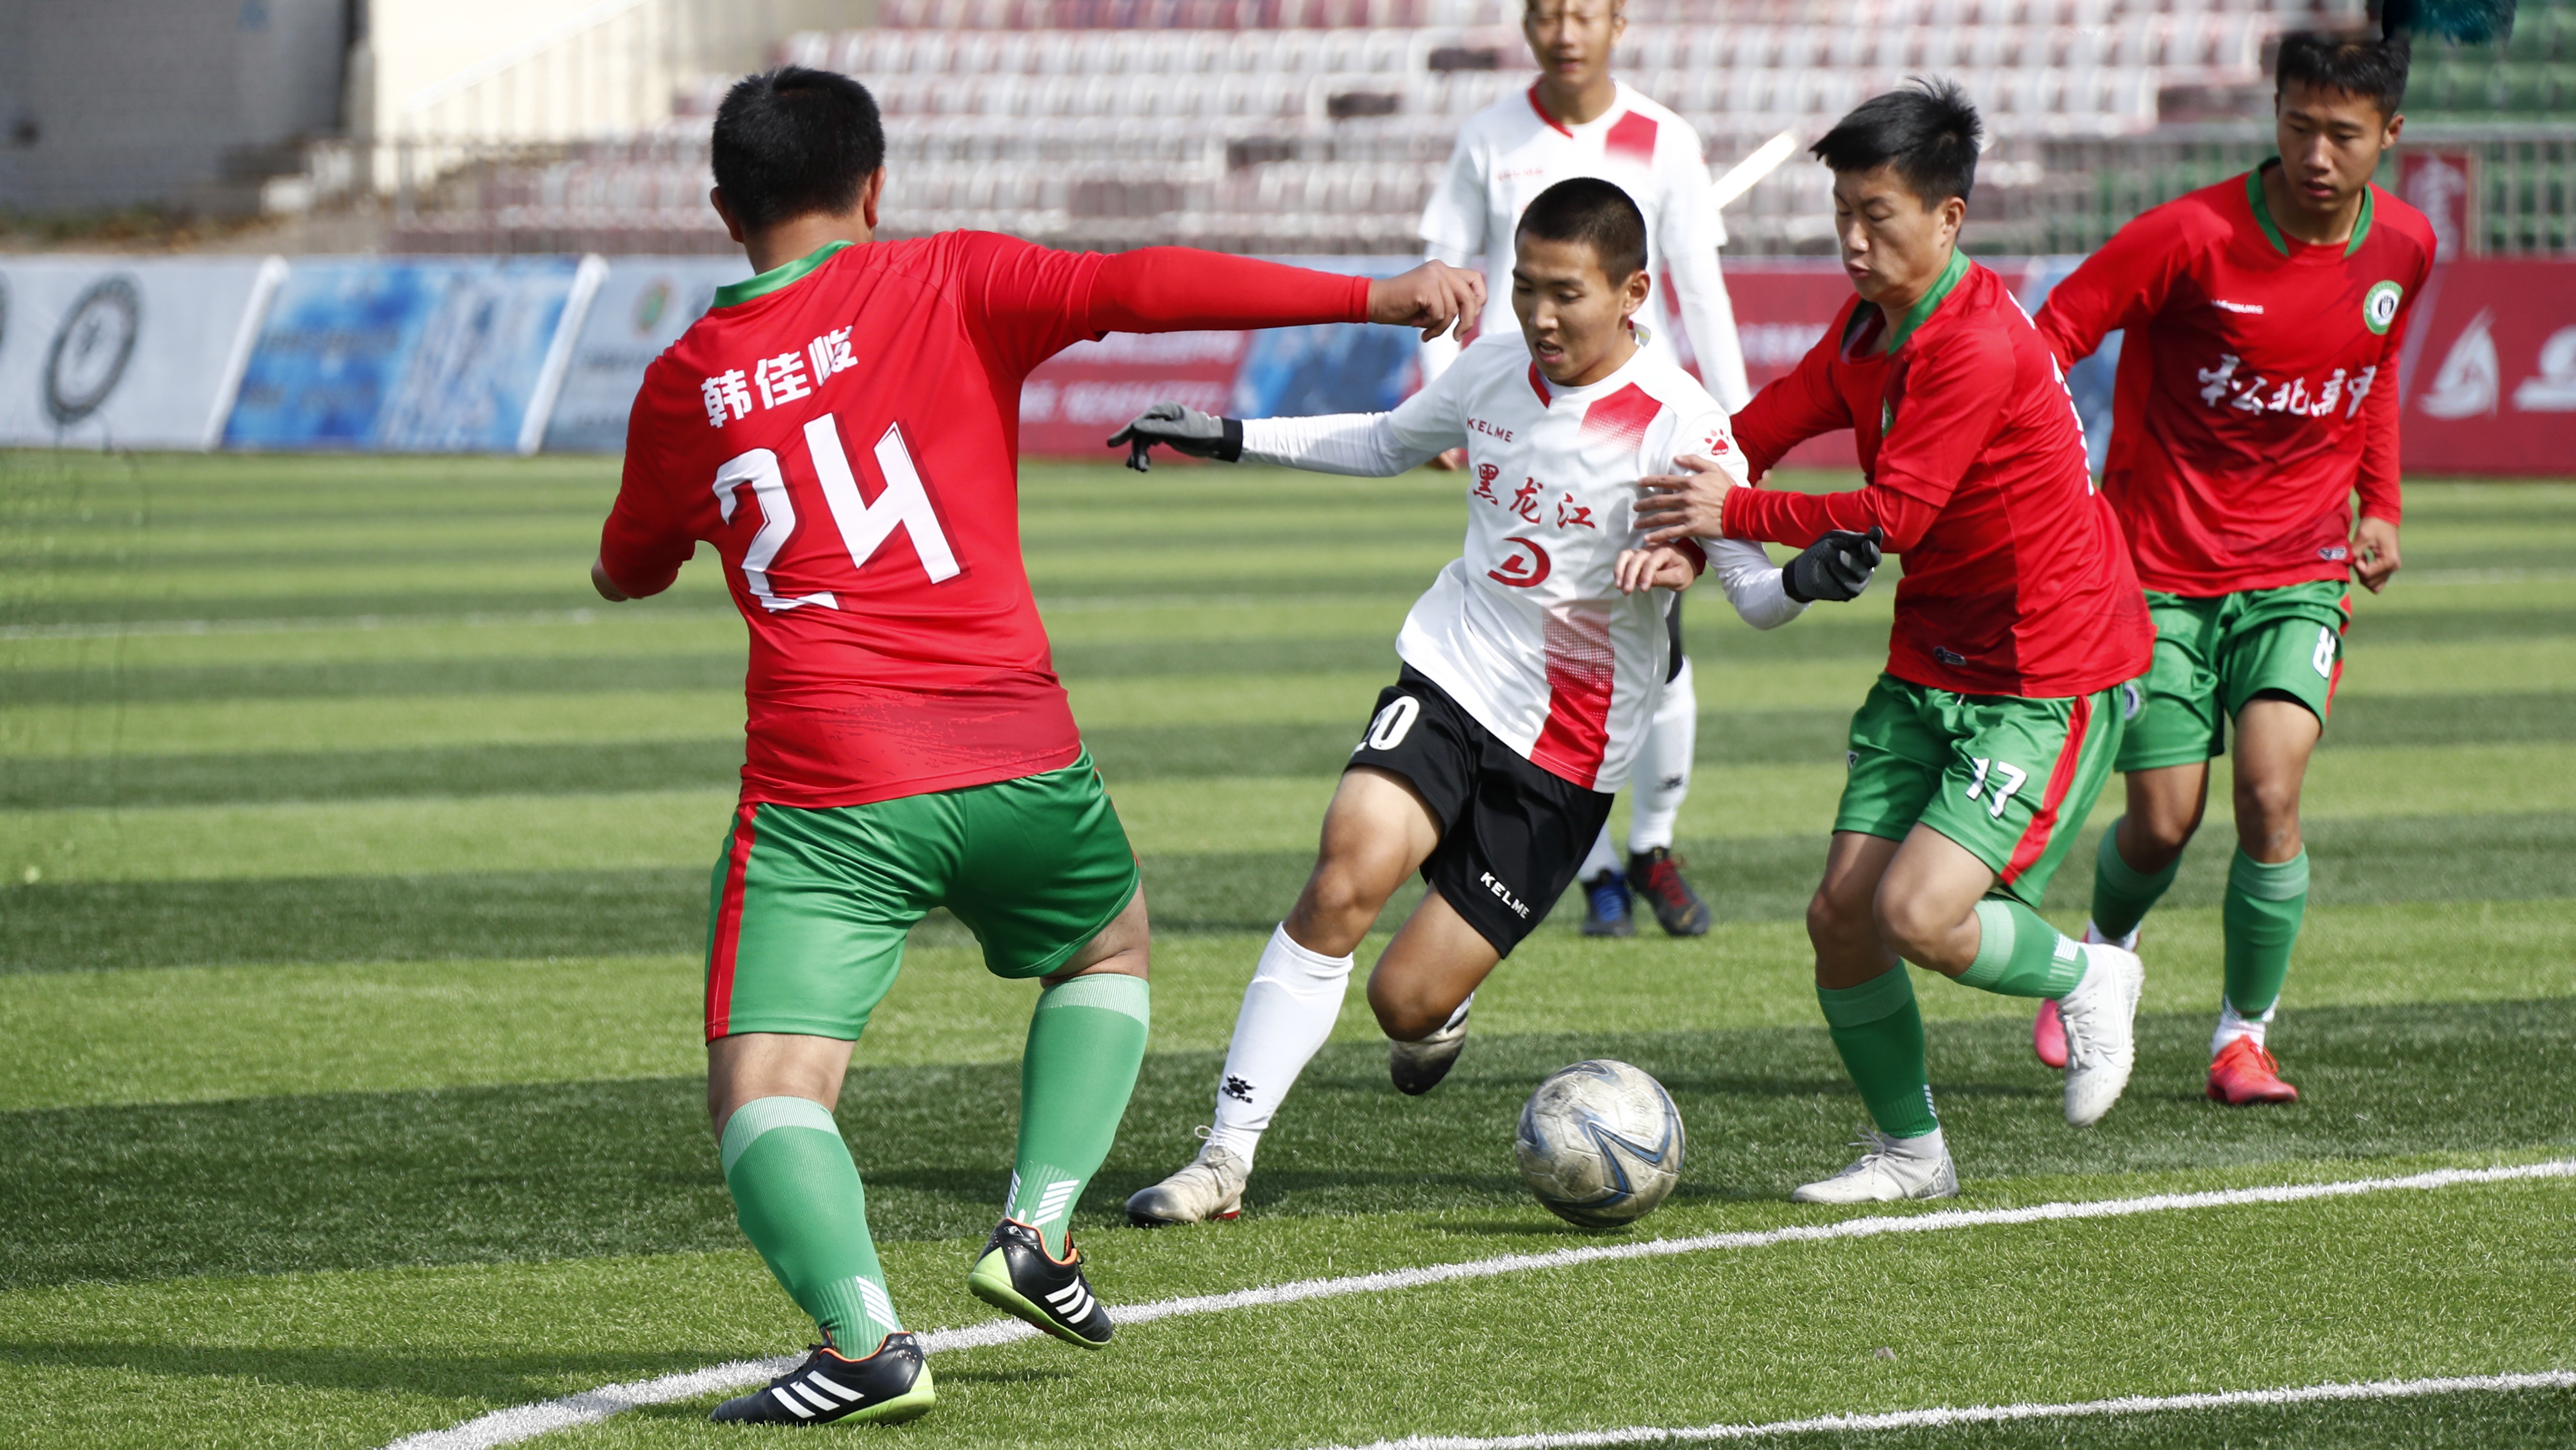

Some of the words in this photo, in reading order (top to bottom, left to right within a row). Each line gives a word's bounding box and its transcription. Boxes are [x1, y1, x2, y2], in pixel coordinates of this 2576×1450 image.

[1467, 417, 1513, 443] KELME
[712, 412, 961, 613] 24
[1473, 463, 1595, 529] 黑龙江
[1965, 757, 2027, 819] 17
[1480, 871, 1530, 919] KELME
